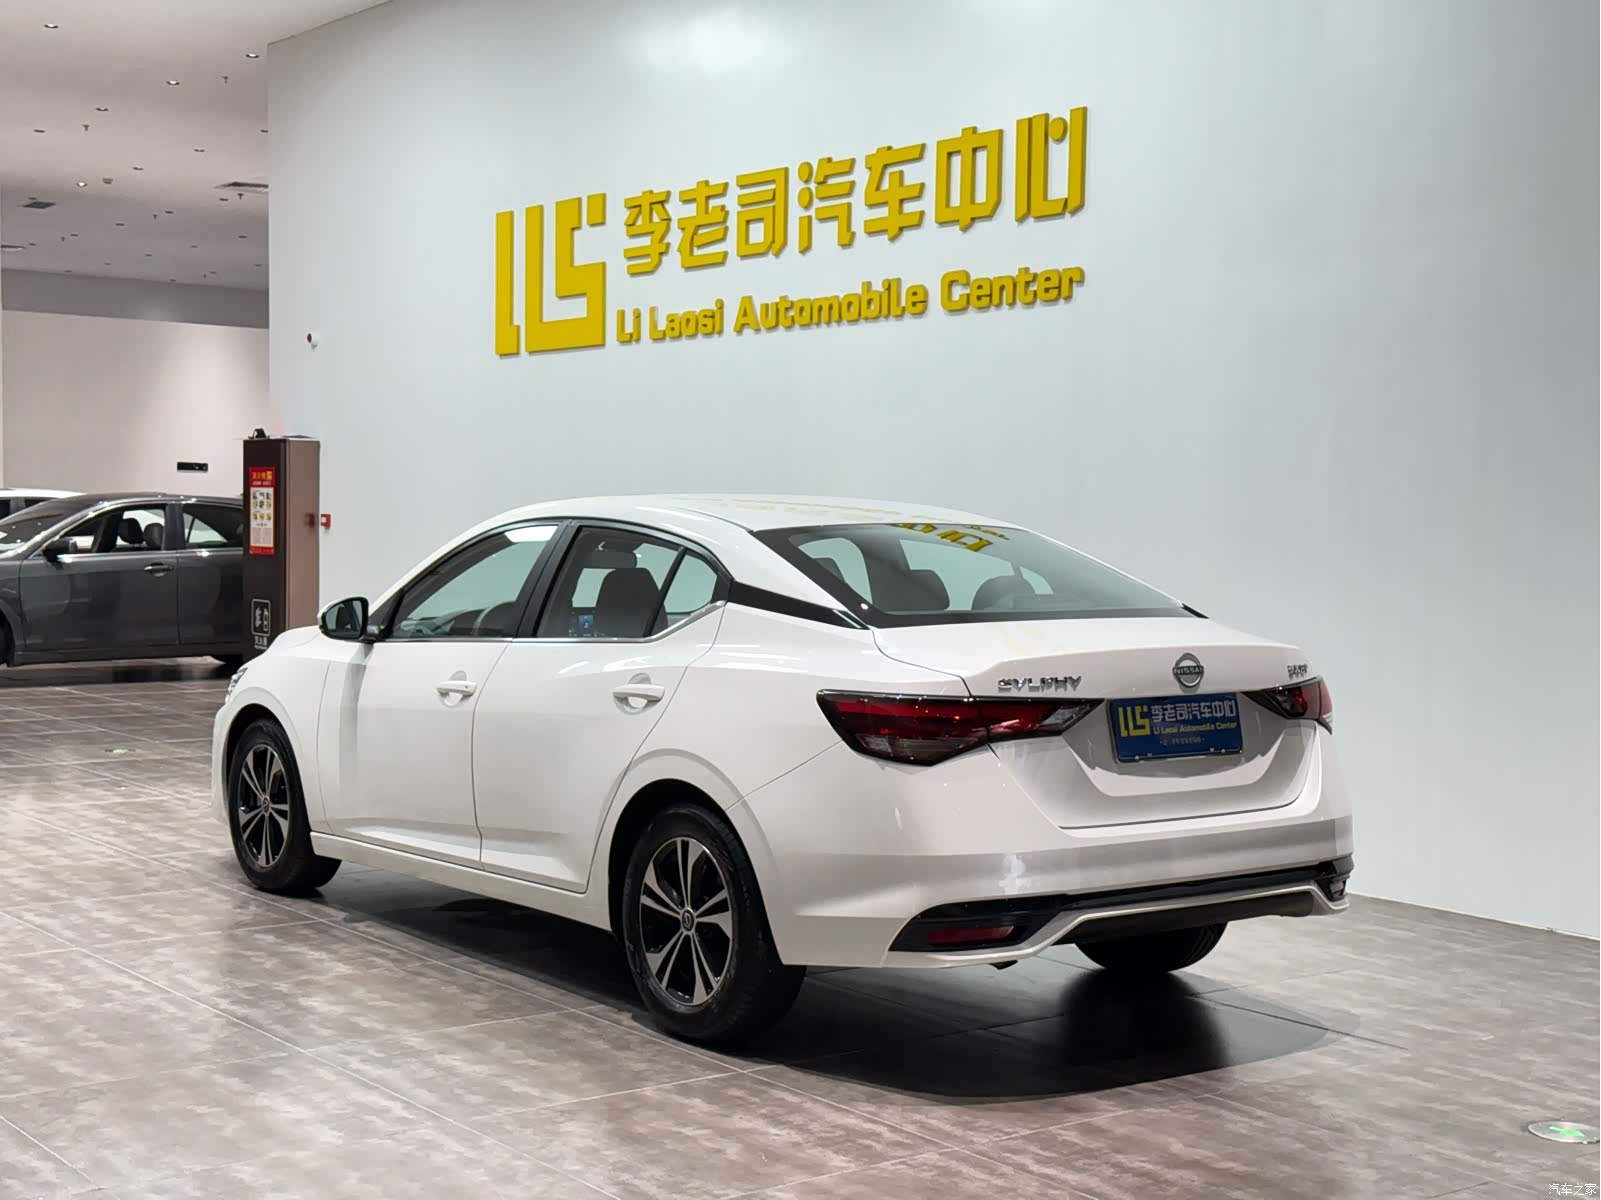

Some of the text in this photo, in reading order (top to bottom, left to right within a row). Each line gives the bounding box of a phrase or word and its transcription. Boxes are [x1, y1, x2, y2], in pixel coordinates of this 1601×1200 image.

[623, 107, 1088, 275] 李老司汽车中心
[616, 267, 1085, 343] Li Laosi Automobile Center
[1173, 666, 1203, 675] NISSAN
[1151, 700, 1236, 722] 李老司汽车中心
